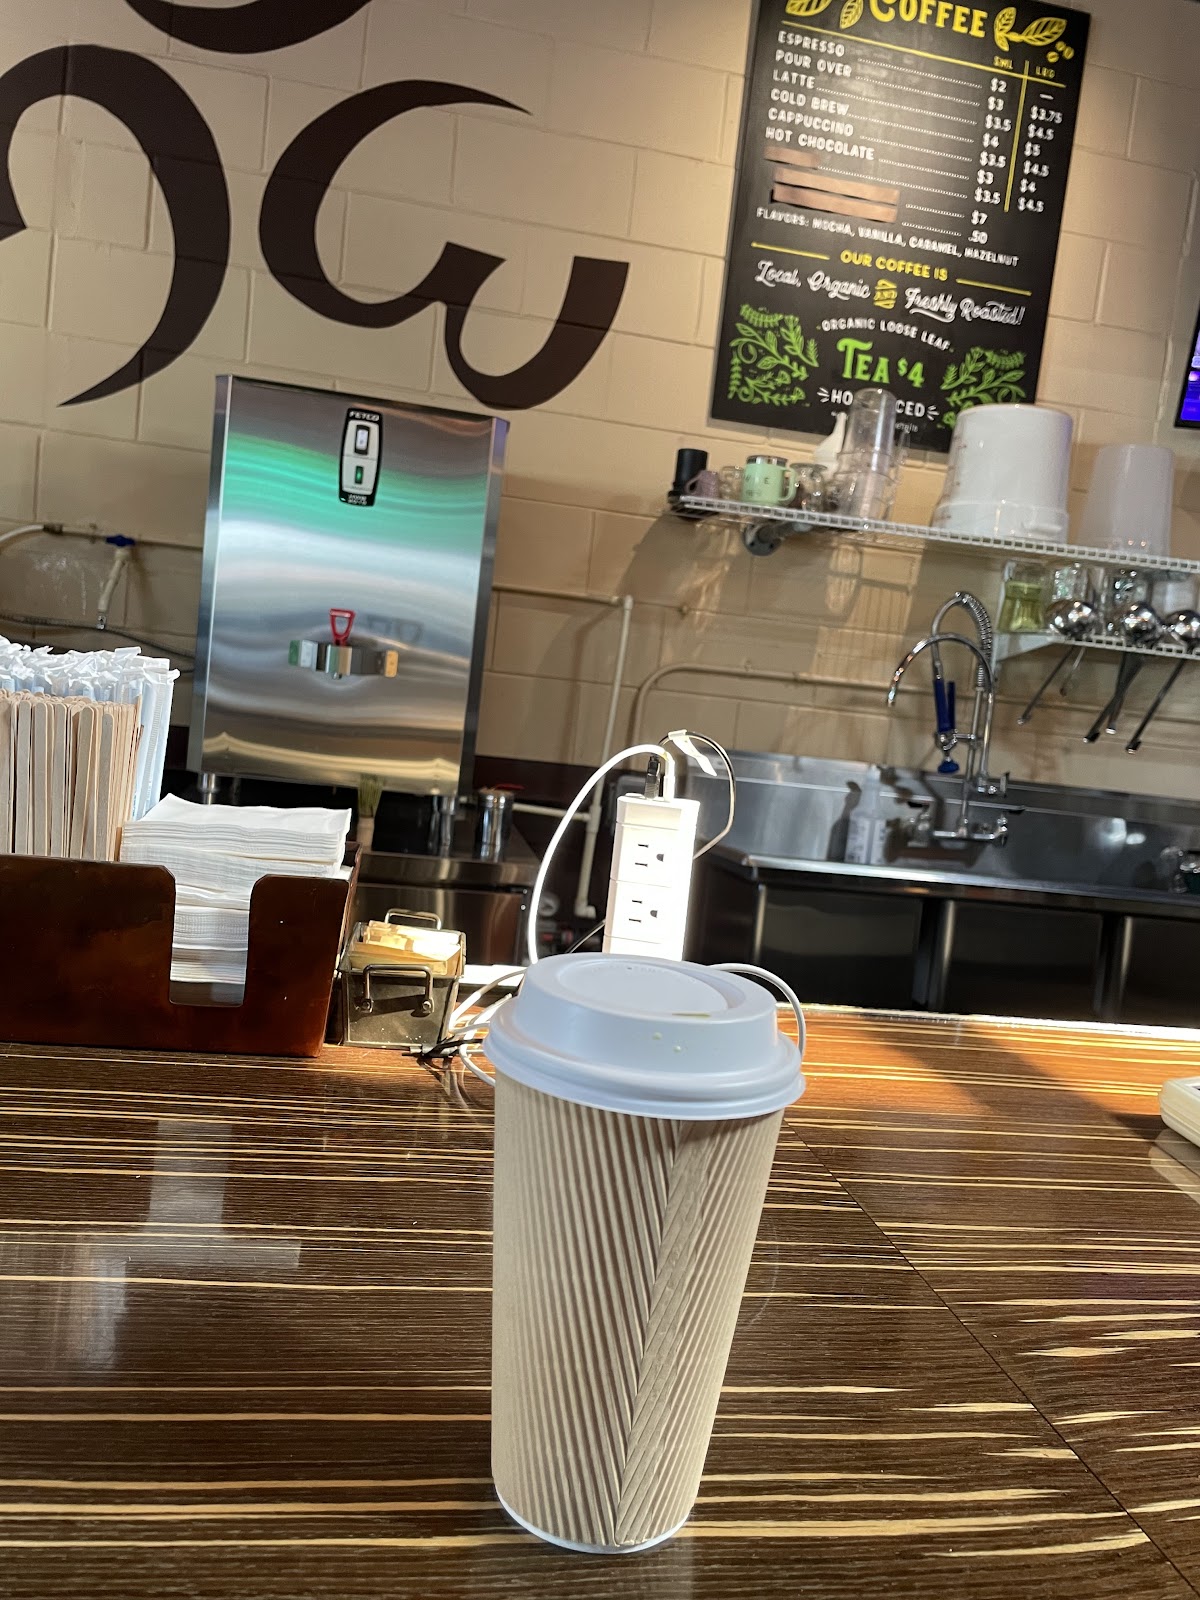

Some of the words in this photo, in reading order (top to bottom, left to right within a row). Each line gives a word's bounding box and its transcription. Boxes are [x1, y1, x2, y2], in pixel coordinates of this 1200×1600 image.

[870, 0, 988, 38] COFFEE
[775, 49, 812, 69] POUR
[816, 58, 852, 77] OVER
[987, 95, 1004, 111] $3
[1030, 105, 1063, 124] $3.75
[777, 30, 845, 57] ESPRESSO
[990, 77, 1007, 93] $2
[770, 88, 806, 107] COLD
[811, 96, 850, 116] BREW
[982, 132, 1000, 148] $4
[1024, 141, 1041, 157] $5
[772, 69, 816, 89] LATTE
[985, 113, 1012, 132] $3.5
[1028, 123, 1055, 140] $4.5
[765, 126, 793, 143] HOT
[798, 133, 875, 161] CHOCOLATE
[976, 168, 994, 185] $3
[1019, 178, 1037, 193] $4
[768, 107, 854, 137] CAPPUCCINO
[979, 150, 1007, 168] $3.5
[1023, 160, 1050, 177] $4.5
[971, 209, 988, 225] $7
[974, 186, 1001, 205] $3.5
[1017, 196, 1044, 213] $4.5
[756, 207, 809, 227] FLAVORS:
[812, 217, 855, 237] MOCHA,
[858, 227, 906, 248] VANILLA,
[909, 235, 962, 258] CARAMEL,
[964, 247, 1020, 267] HAZELNUT
[968, 229, 988, 244] .50
[754, 260, 802, 288] Local,
[806, 270, 871, 301] Organic
[904, 287, 958, 323] Freshly
[960, 297, 1026, 325] Roasted!
[840, 249, 872, 267] OUR
[875, 256, 931, 279] COFFEE
[933, 267, 948, 281] IS
[821, 318, 876, 332] ORGANIC
[880, 320, 918, 339] LOOSE
[920, 330, 951, 351] LEAF
[836, 337, 890, 384] TEA
[897, 357, 925, 389] $4
[830, 388, 854, 406] HO
[895, 399, 926, 417] CED
